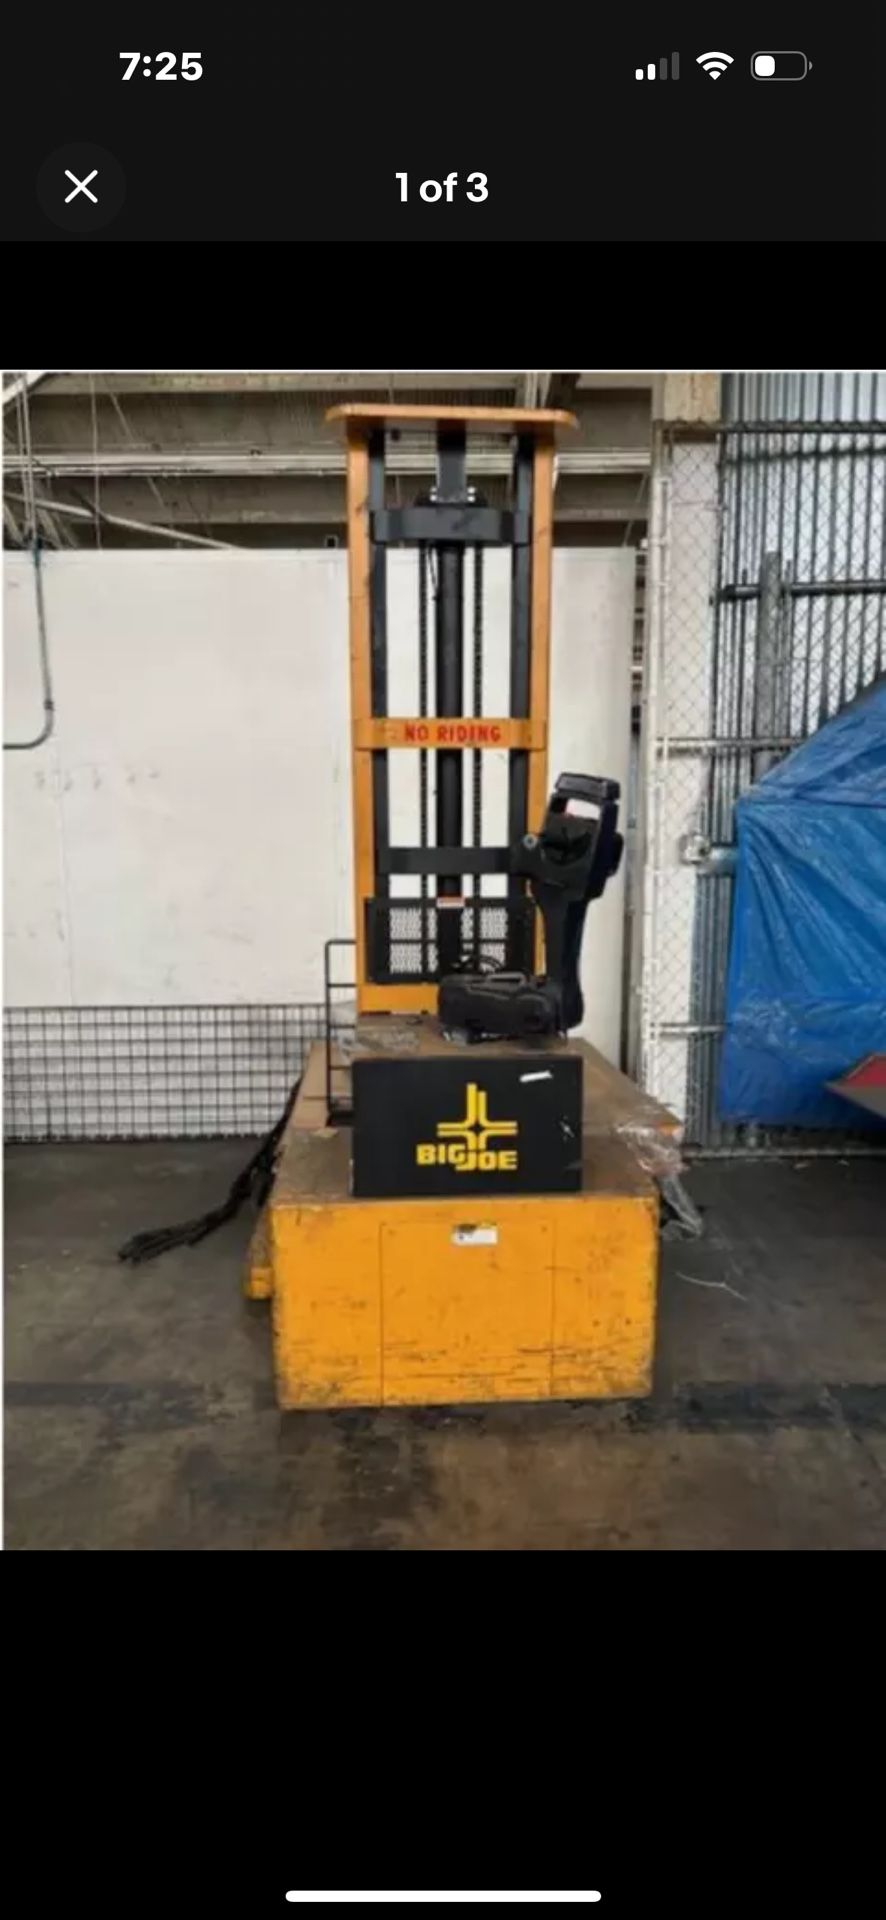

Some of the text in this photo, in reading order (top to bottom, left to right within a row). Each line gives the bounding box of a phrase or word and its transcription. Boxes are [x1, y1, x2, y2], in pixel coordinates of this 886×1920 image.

[404, 724, 502, 742] NO RIDING
[416, 1143, 518, 1171] BIG JOE
